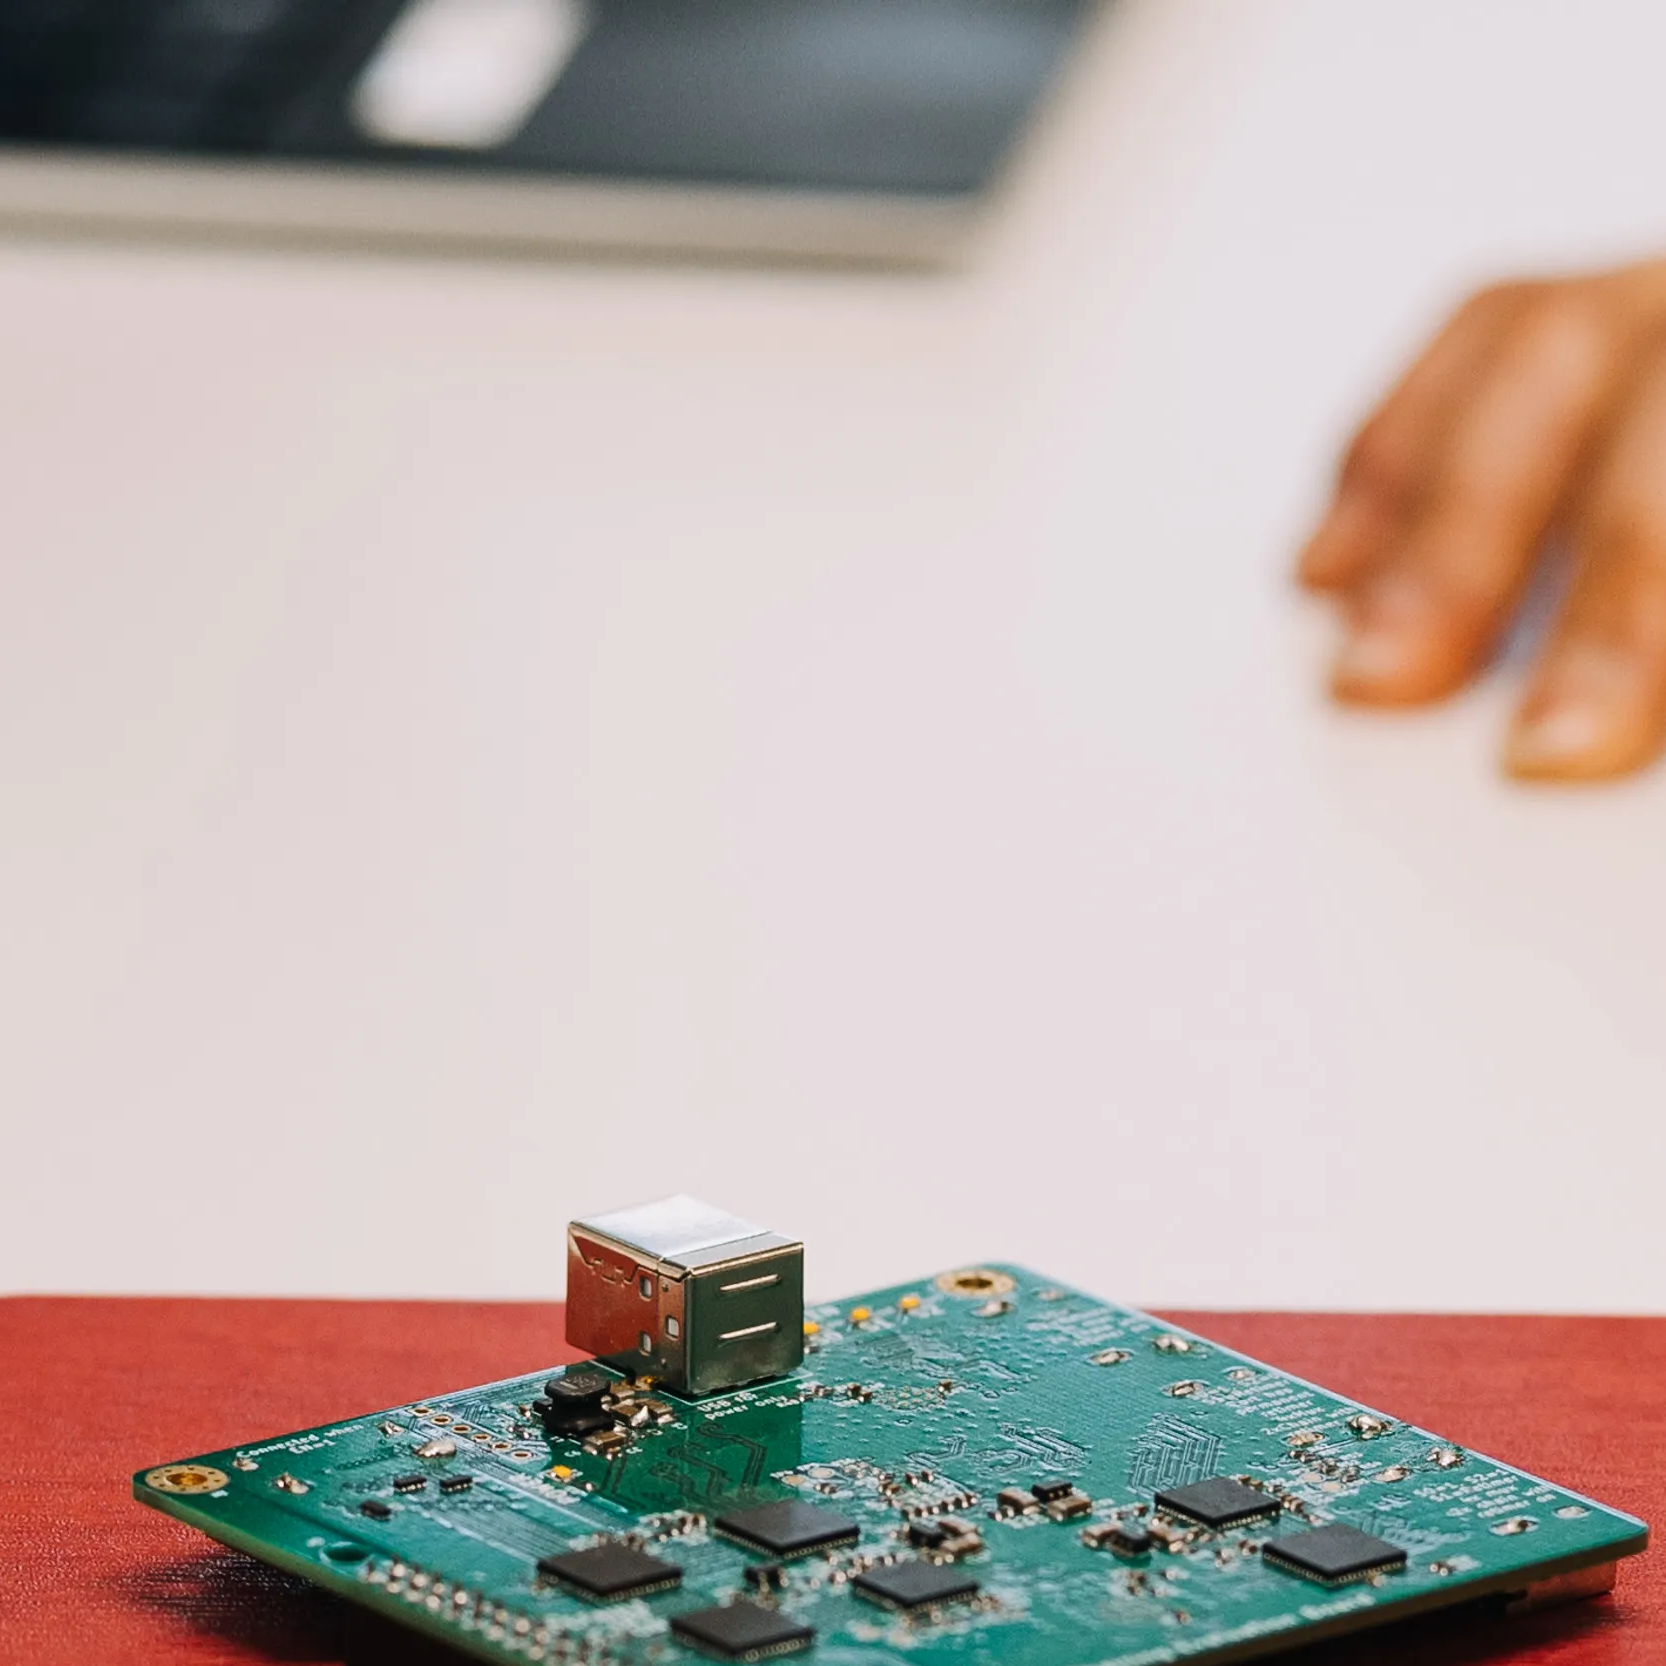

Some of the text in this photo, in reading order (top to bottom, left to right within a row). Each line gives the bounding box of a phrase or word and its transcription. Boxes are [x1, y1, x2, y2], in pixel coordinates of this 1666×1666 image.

[697, 1399, 732, 1412] USB
[704, 1404, 749, 1421] power
[235, 1424, 365, 1458] Connected when
